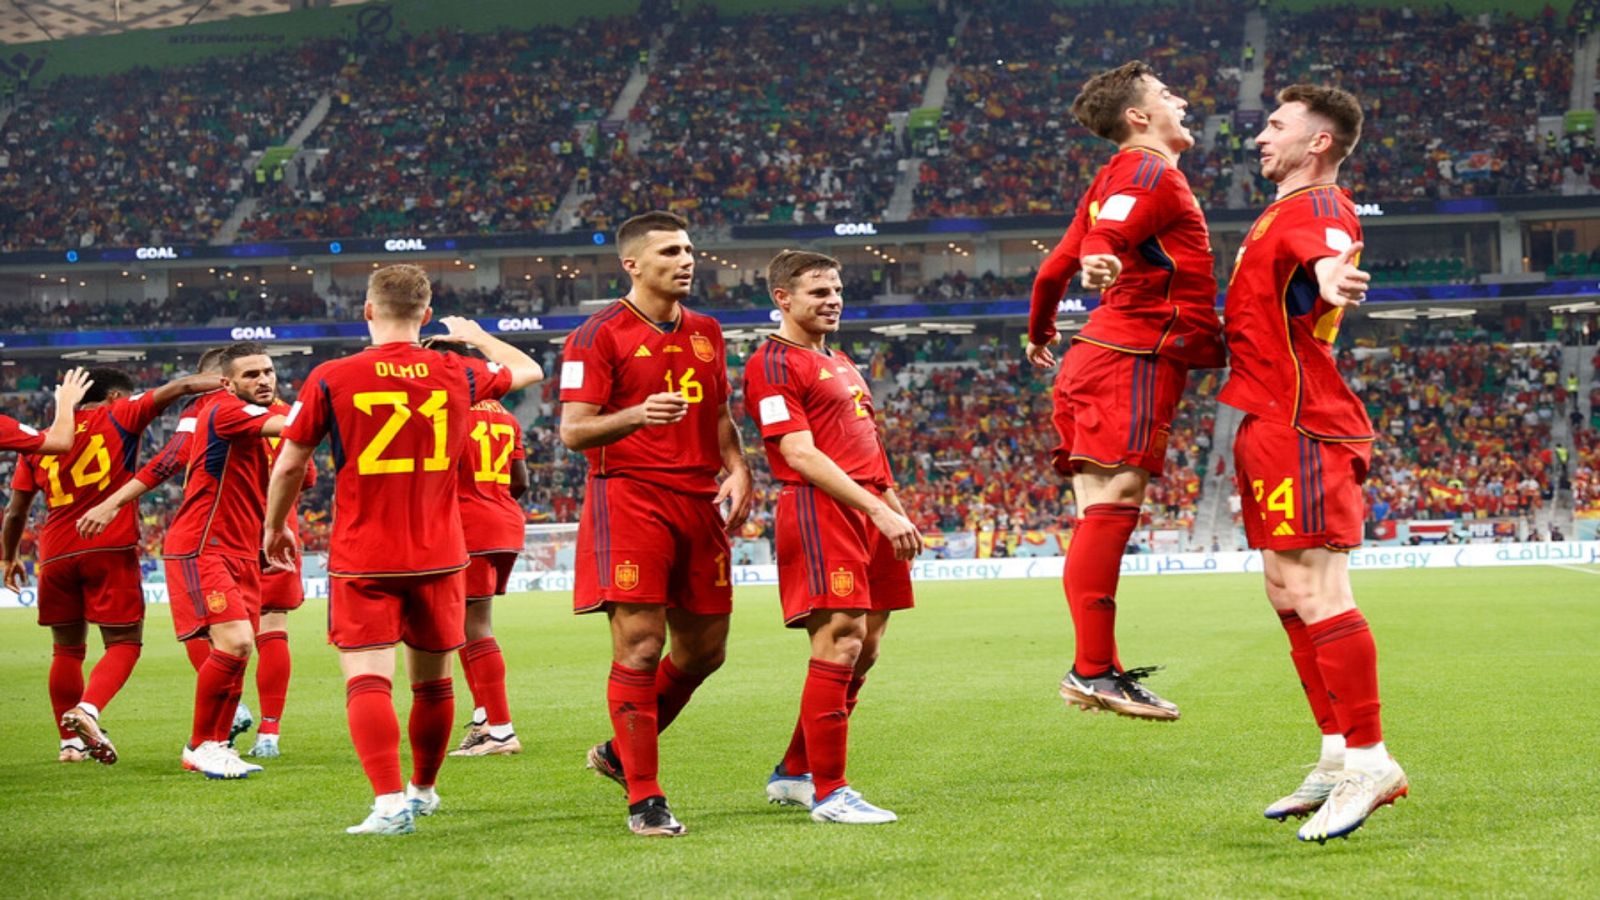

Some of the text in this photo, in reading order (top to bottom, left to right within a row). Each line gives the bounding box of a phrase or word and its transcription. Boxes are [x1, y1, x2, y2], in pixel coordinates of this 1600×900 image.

[1354, 203, 1384, 216] OAL
[835, 223, 877, 235] GOAL
[136, 247, 178, 259] GOAL
[384, 239, 427, 251] GOAL
[498, 318, 543, 331] GOAL
[231, 327, 276, 340] GOAL
[375, 361, 429, 378] OLMO
[664, 367, 703, 403] 16
[353, 390, 450, 475] 21
[470, 421, 515, 485] 12
[39, 434, 111, 508] 14
[1349, 550, 1431, 567] Energy
[911, 562, 1003, 579] rEnergy
